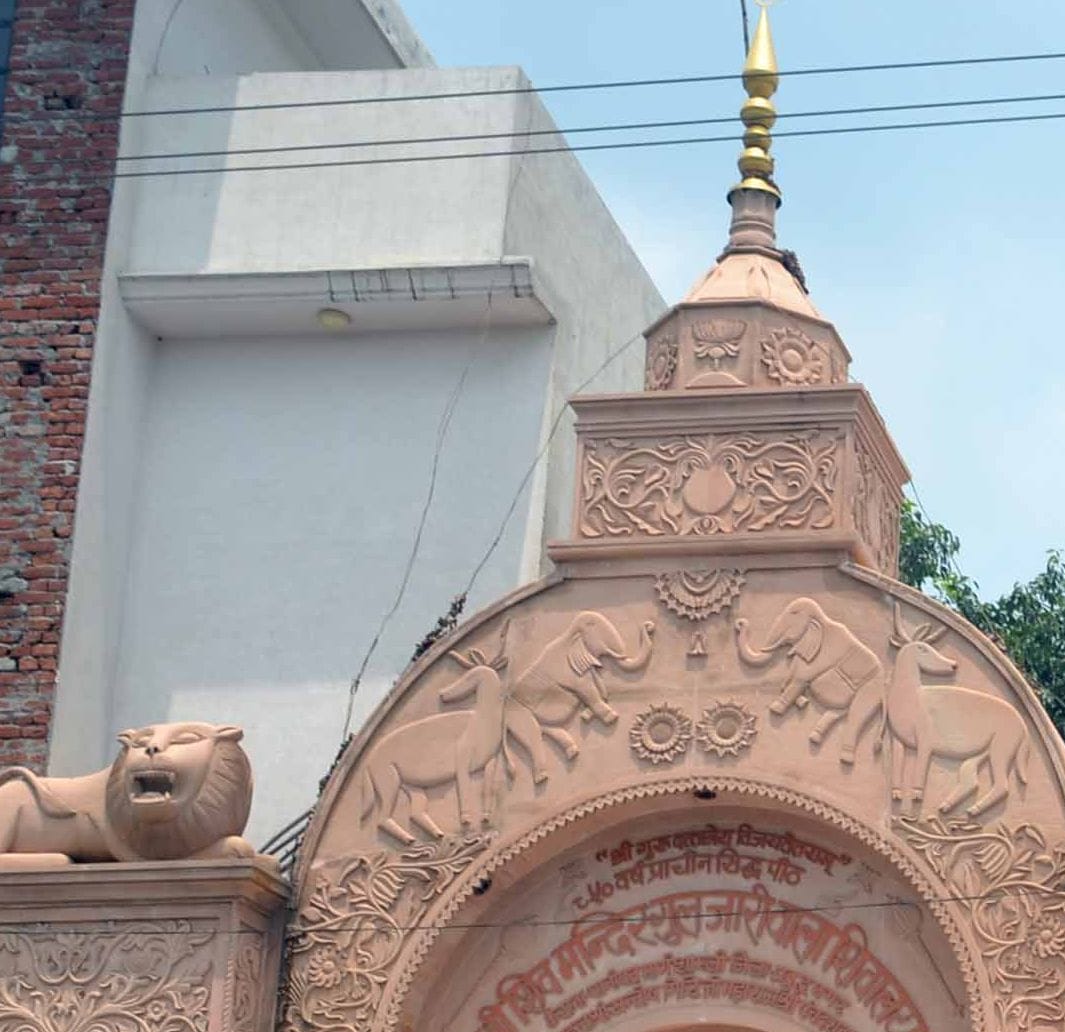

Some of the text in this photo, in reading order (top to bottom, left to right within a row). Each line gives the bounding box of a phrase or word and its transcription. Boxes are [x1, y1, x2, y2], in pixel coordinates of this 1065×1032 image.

[613, 859, 644, 891] वर्ष
[647, 849, 711, 882] प्राचीन
[766, 857, 806, 887] पीठ
[496, 957, 563, 1027] शिव
